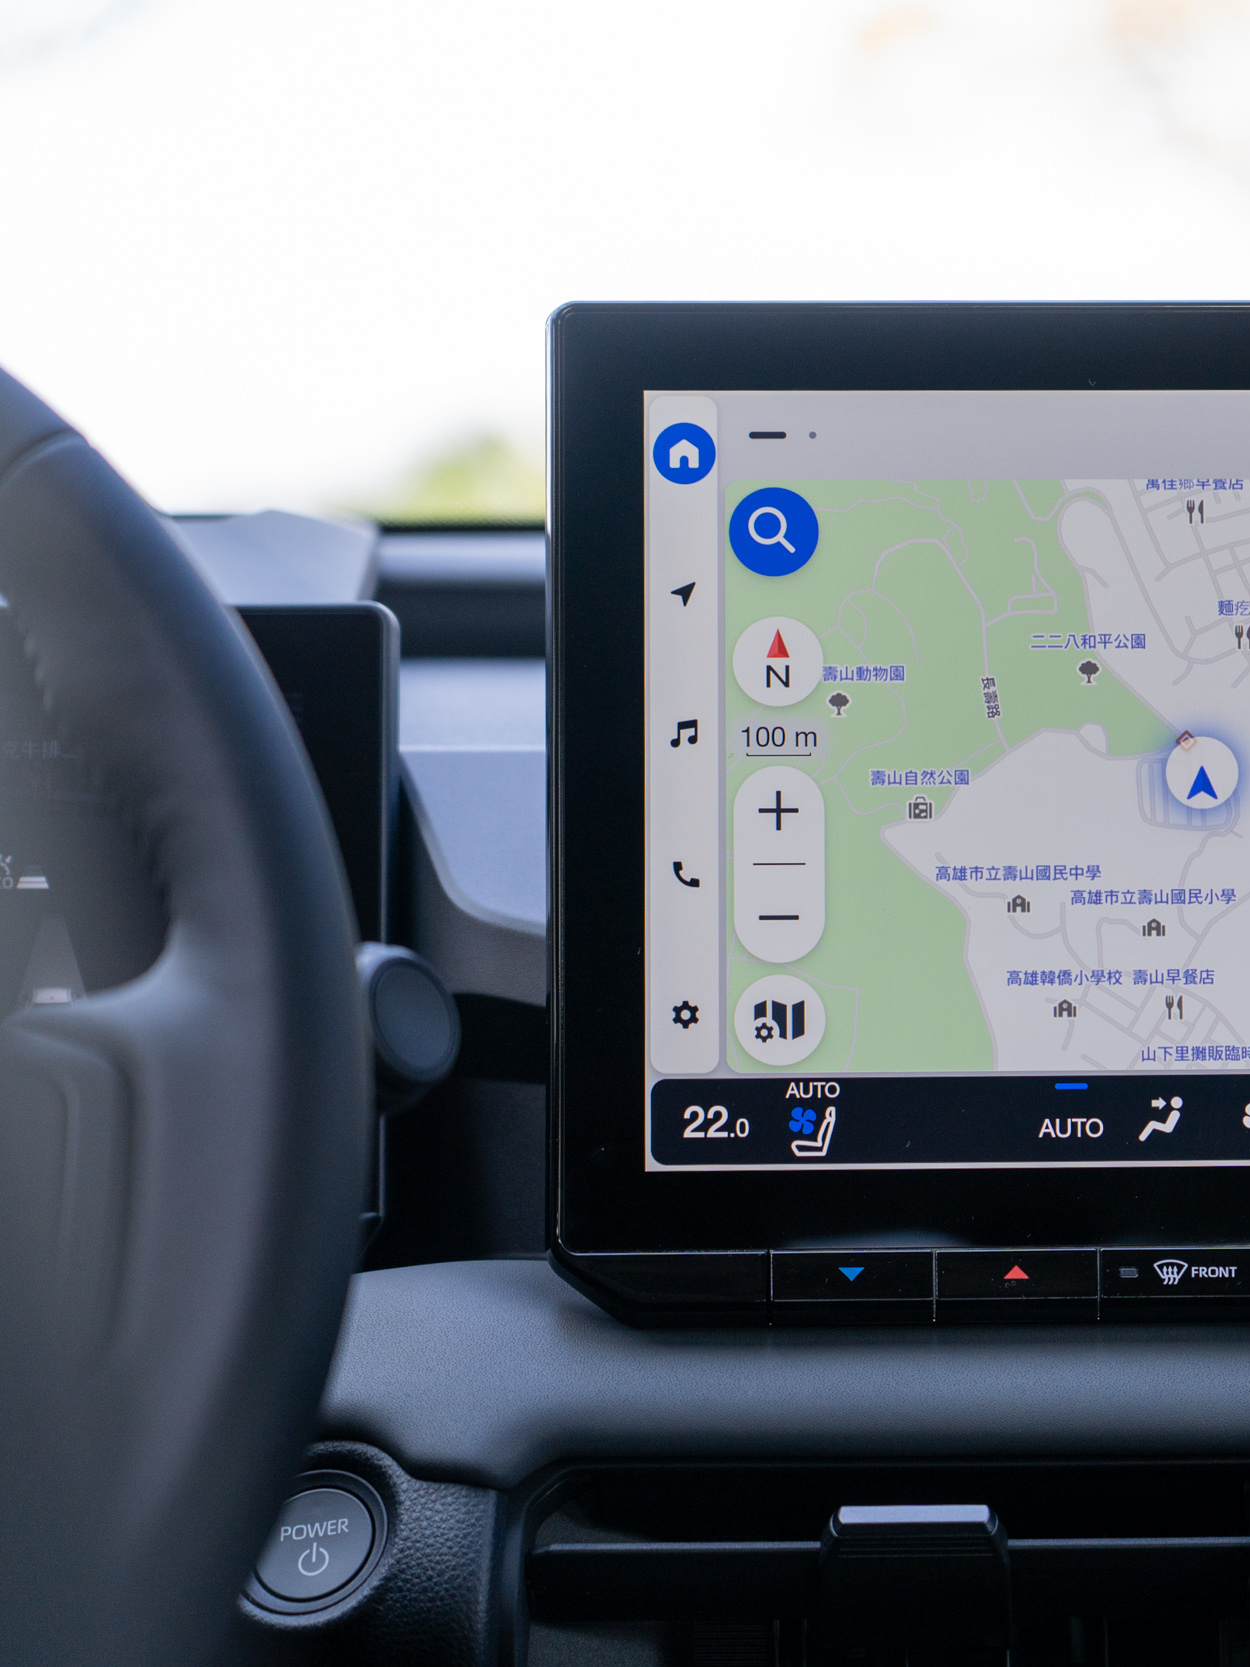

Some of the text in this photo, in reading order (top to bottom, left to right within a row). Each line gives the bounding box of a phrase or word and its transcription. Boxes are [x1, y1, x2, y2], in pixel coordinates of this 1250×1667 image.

[1030, 633, 1146, 650] 二二八和平公園
[765, 665, 790, 688] N
[822, 665, 905, 682] 壽山動物園
[980, 676, 1001, 718] 長壽路
[741, 726, 818, 747] 100 m
[870, 769, 970, 786] 壽山自然公園
[935, 865, 1102, 882] 高雄市立壽山國民中學
[1070, 889, 1237, 905] 高雄市立壽山國民小學
[1006, 970, 1123, 986] 高雄韓僑小學校
[1132, 969, 1215, 985] 壽山早餐店
[785, 1082, 840, 1099] AUTO
[683, 1105, 750, 1139] 22.0
[1038, 1118, 1104, 1138] AUTO
[1191, 1266, 1238, 1278] FRONT
[280, 1518, 349, 1541] POWER
